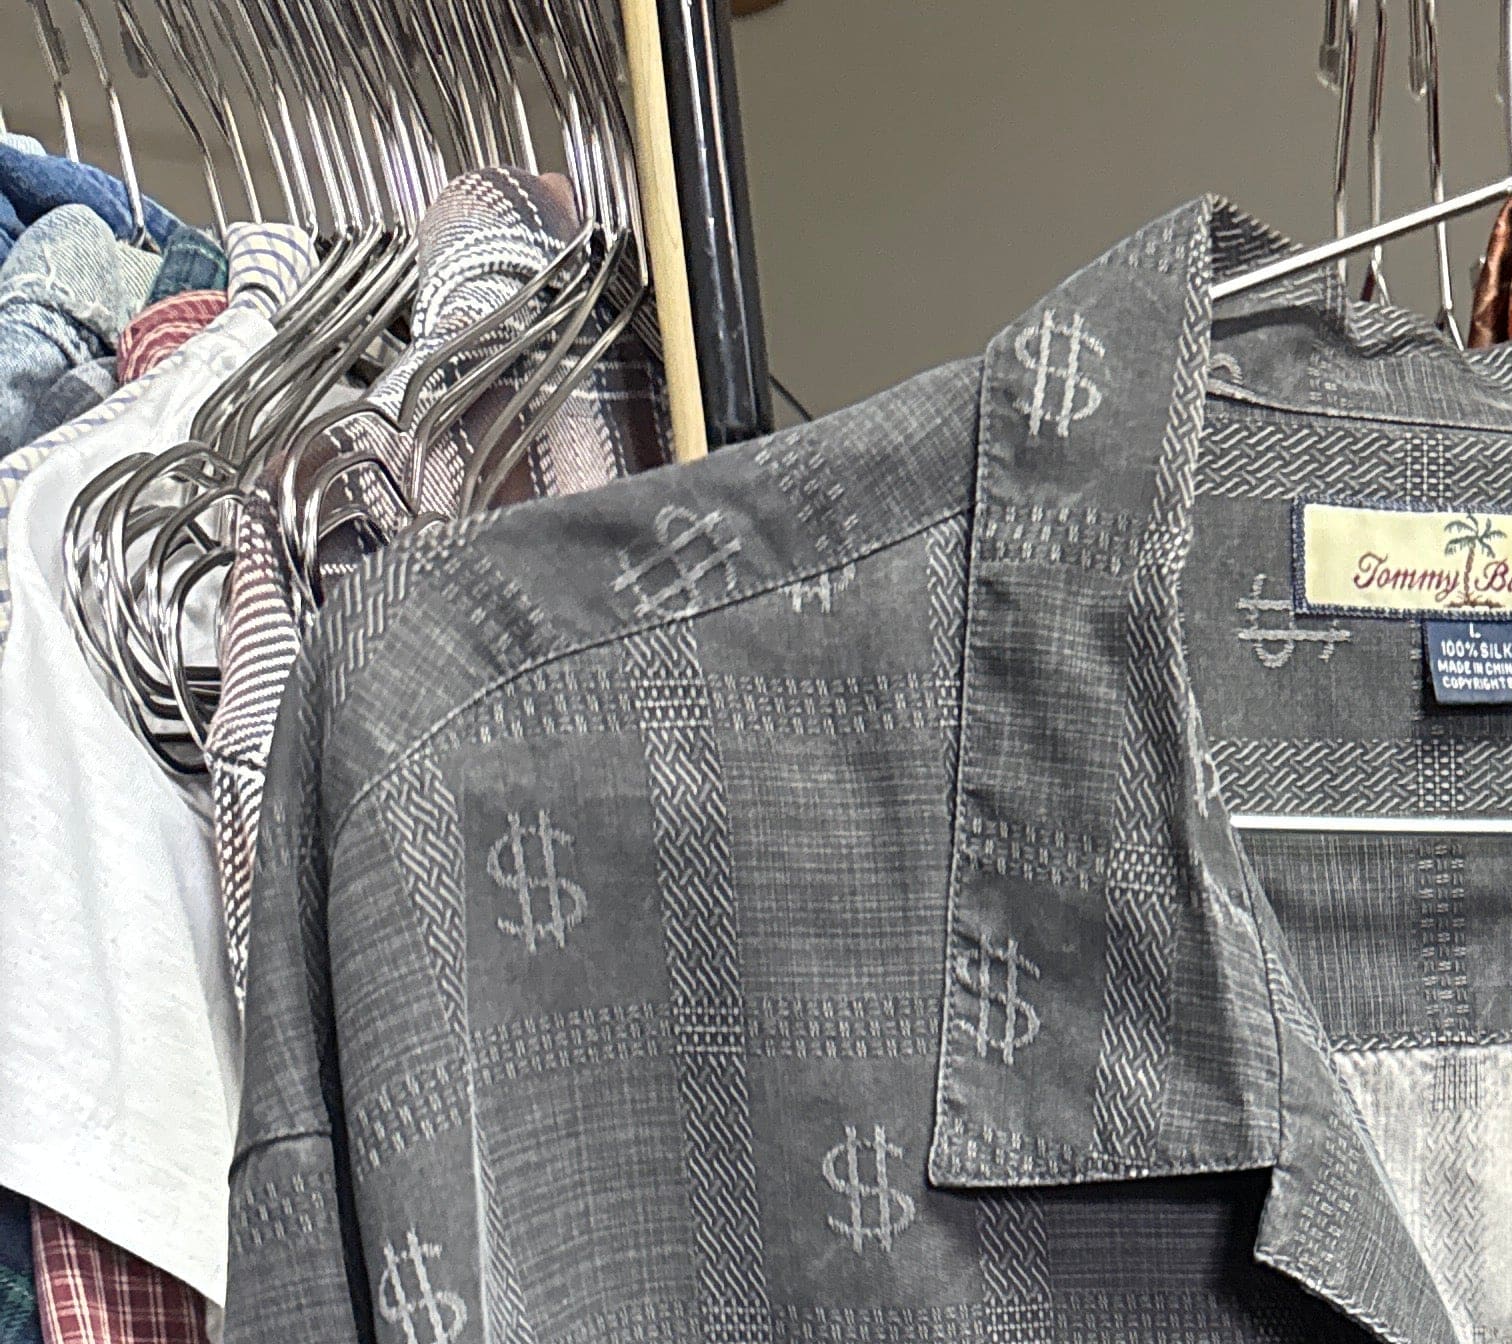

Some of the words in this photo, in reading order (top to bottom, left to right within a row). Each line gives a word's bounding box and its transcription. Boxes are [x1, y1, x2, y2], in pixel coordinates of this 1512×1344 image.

[1353, 552, 1460, 602] Tommy
[1441, 639, 1478, 658] 100%
[1480, 642, 1512, 659] SILK
[1437, 659, 1471, 675] MADE
[1472, 662, 1483, 675] IN
